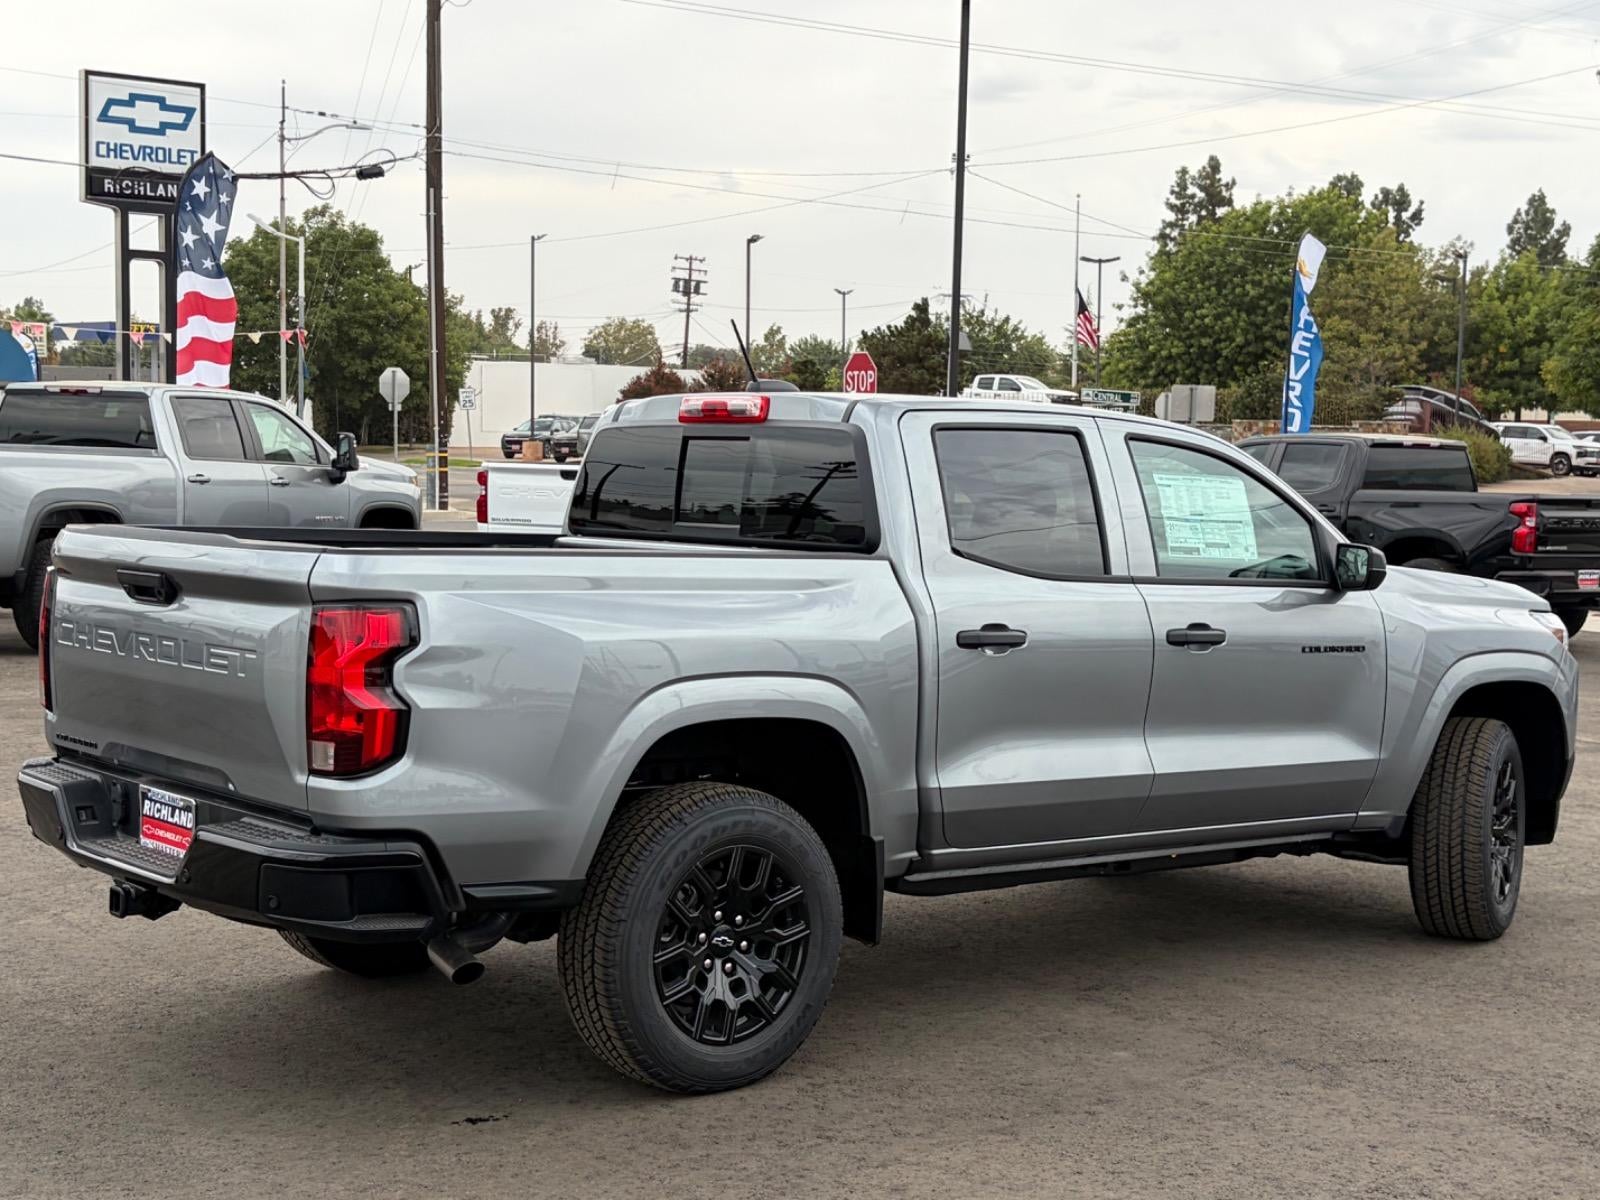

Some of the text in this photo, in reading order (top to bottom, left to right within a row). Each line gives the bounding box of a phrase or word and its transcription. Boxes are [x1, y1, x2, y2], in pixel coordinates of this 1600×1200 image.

[95, 140, 198, 166] CHEVROLET
[104, 178, 178, 198] RICHLAN
[1286, 293, 1319, 433] HEVRO
[846, 370, 875, 392] STOP
[462, 399, 474, 409] 25
[56, 617, 257, 678] CHEVROLET
[143, 798, 194, 829] RICHLAND
